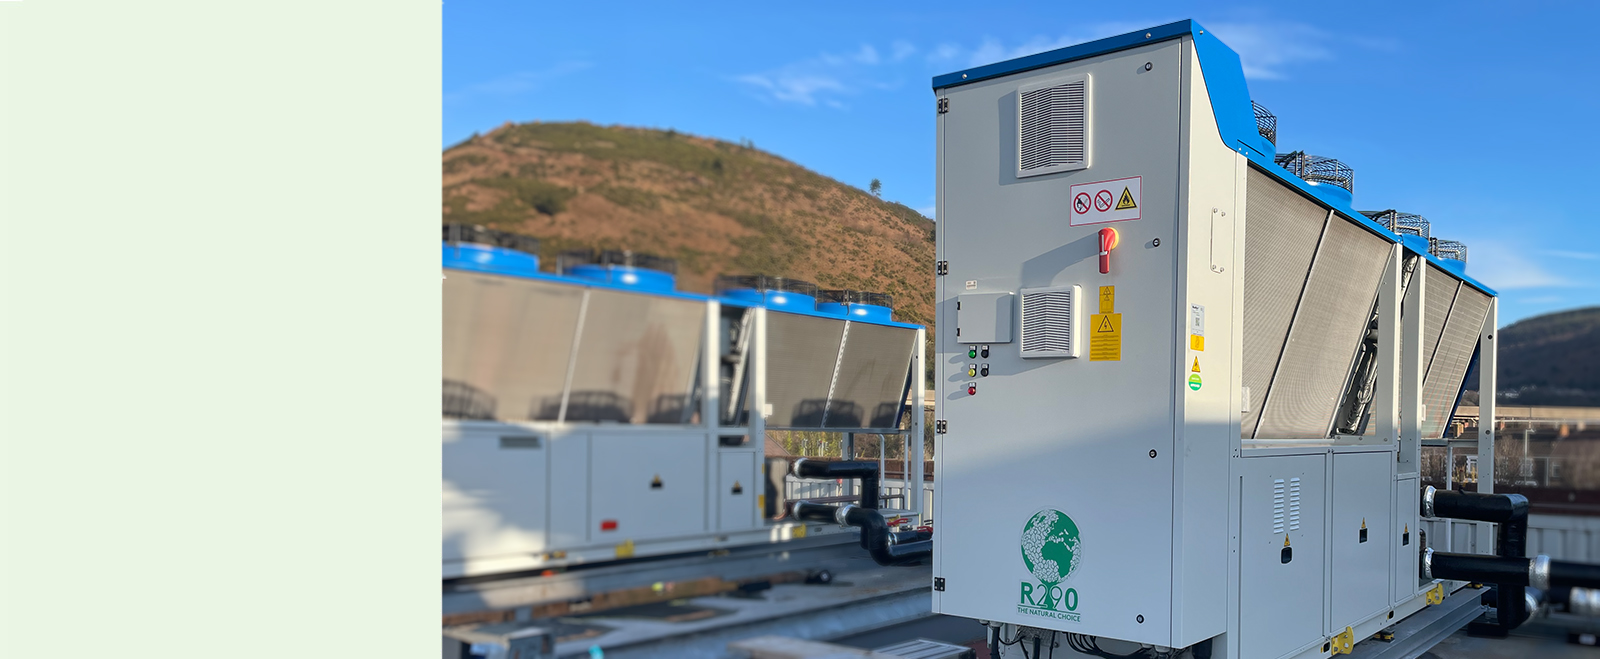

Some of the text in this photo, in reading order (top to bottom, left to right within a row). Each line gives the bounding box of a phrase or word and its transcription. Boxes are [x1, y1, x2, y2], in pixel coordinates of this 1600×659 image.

[1020, 581, 1078, 611] R290
[1017, 607, 1081, 622] THE NATURAL CHOICE
